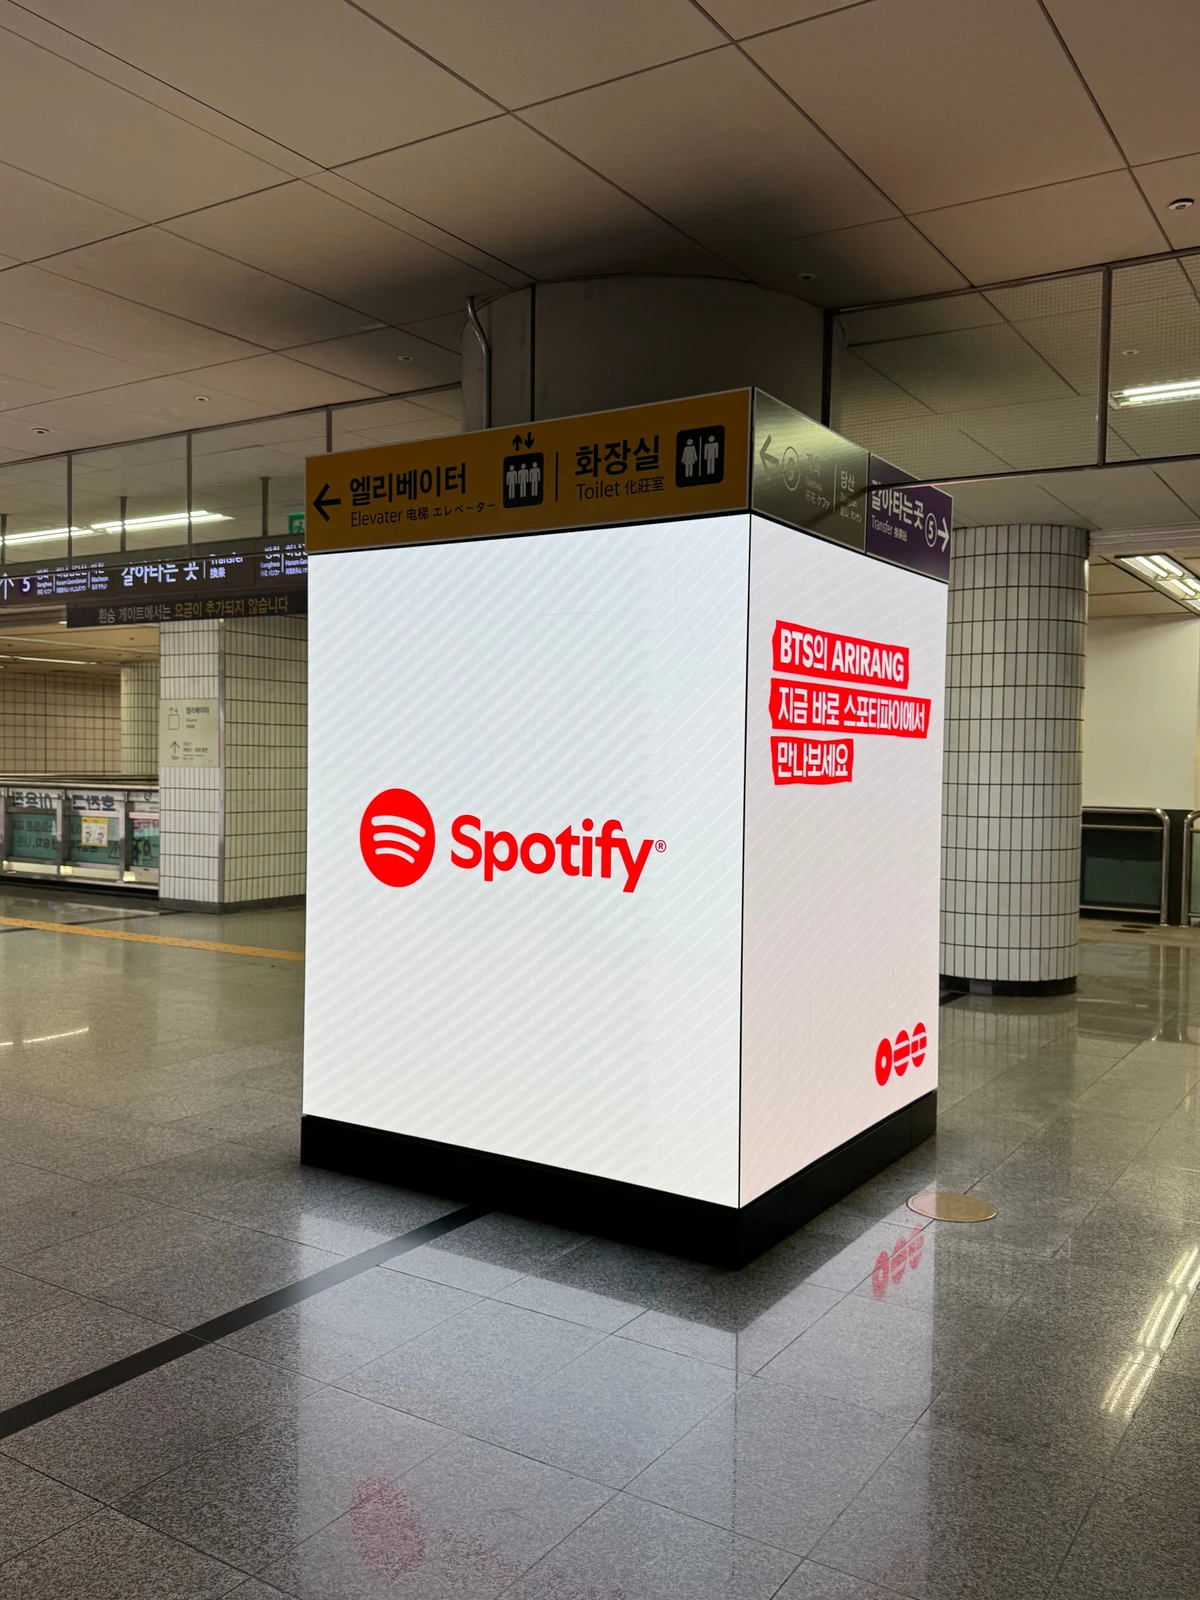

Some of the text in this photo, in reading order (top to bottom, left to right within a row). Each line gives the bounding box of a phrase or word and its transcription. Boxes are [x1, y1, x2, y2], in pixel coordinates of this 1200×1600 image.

[574, 435, 660, 478] 화장실
[350, 463, 466, 507] 엘리베이터
[576, 481, 620, 500] Toilet
[840, 470, 855, 493] 당산
[351, 501, 496, 527] Elevater 电梯 エレベーター
[871, 514, 893, 536] Transfer
[121, 560, 179, 586] 갈아타는
[99, 596, 289, 624] 환승 게이트에서는 요금이 추가되지 않습니다
[780, 628, 904, 682] BTS의 ARIRANG
[778, 686, 926, 732] 지금 바로 스포티파이에서
[777, 742, 848, 778] 만나보세요
